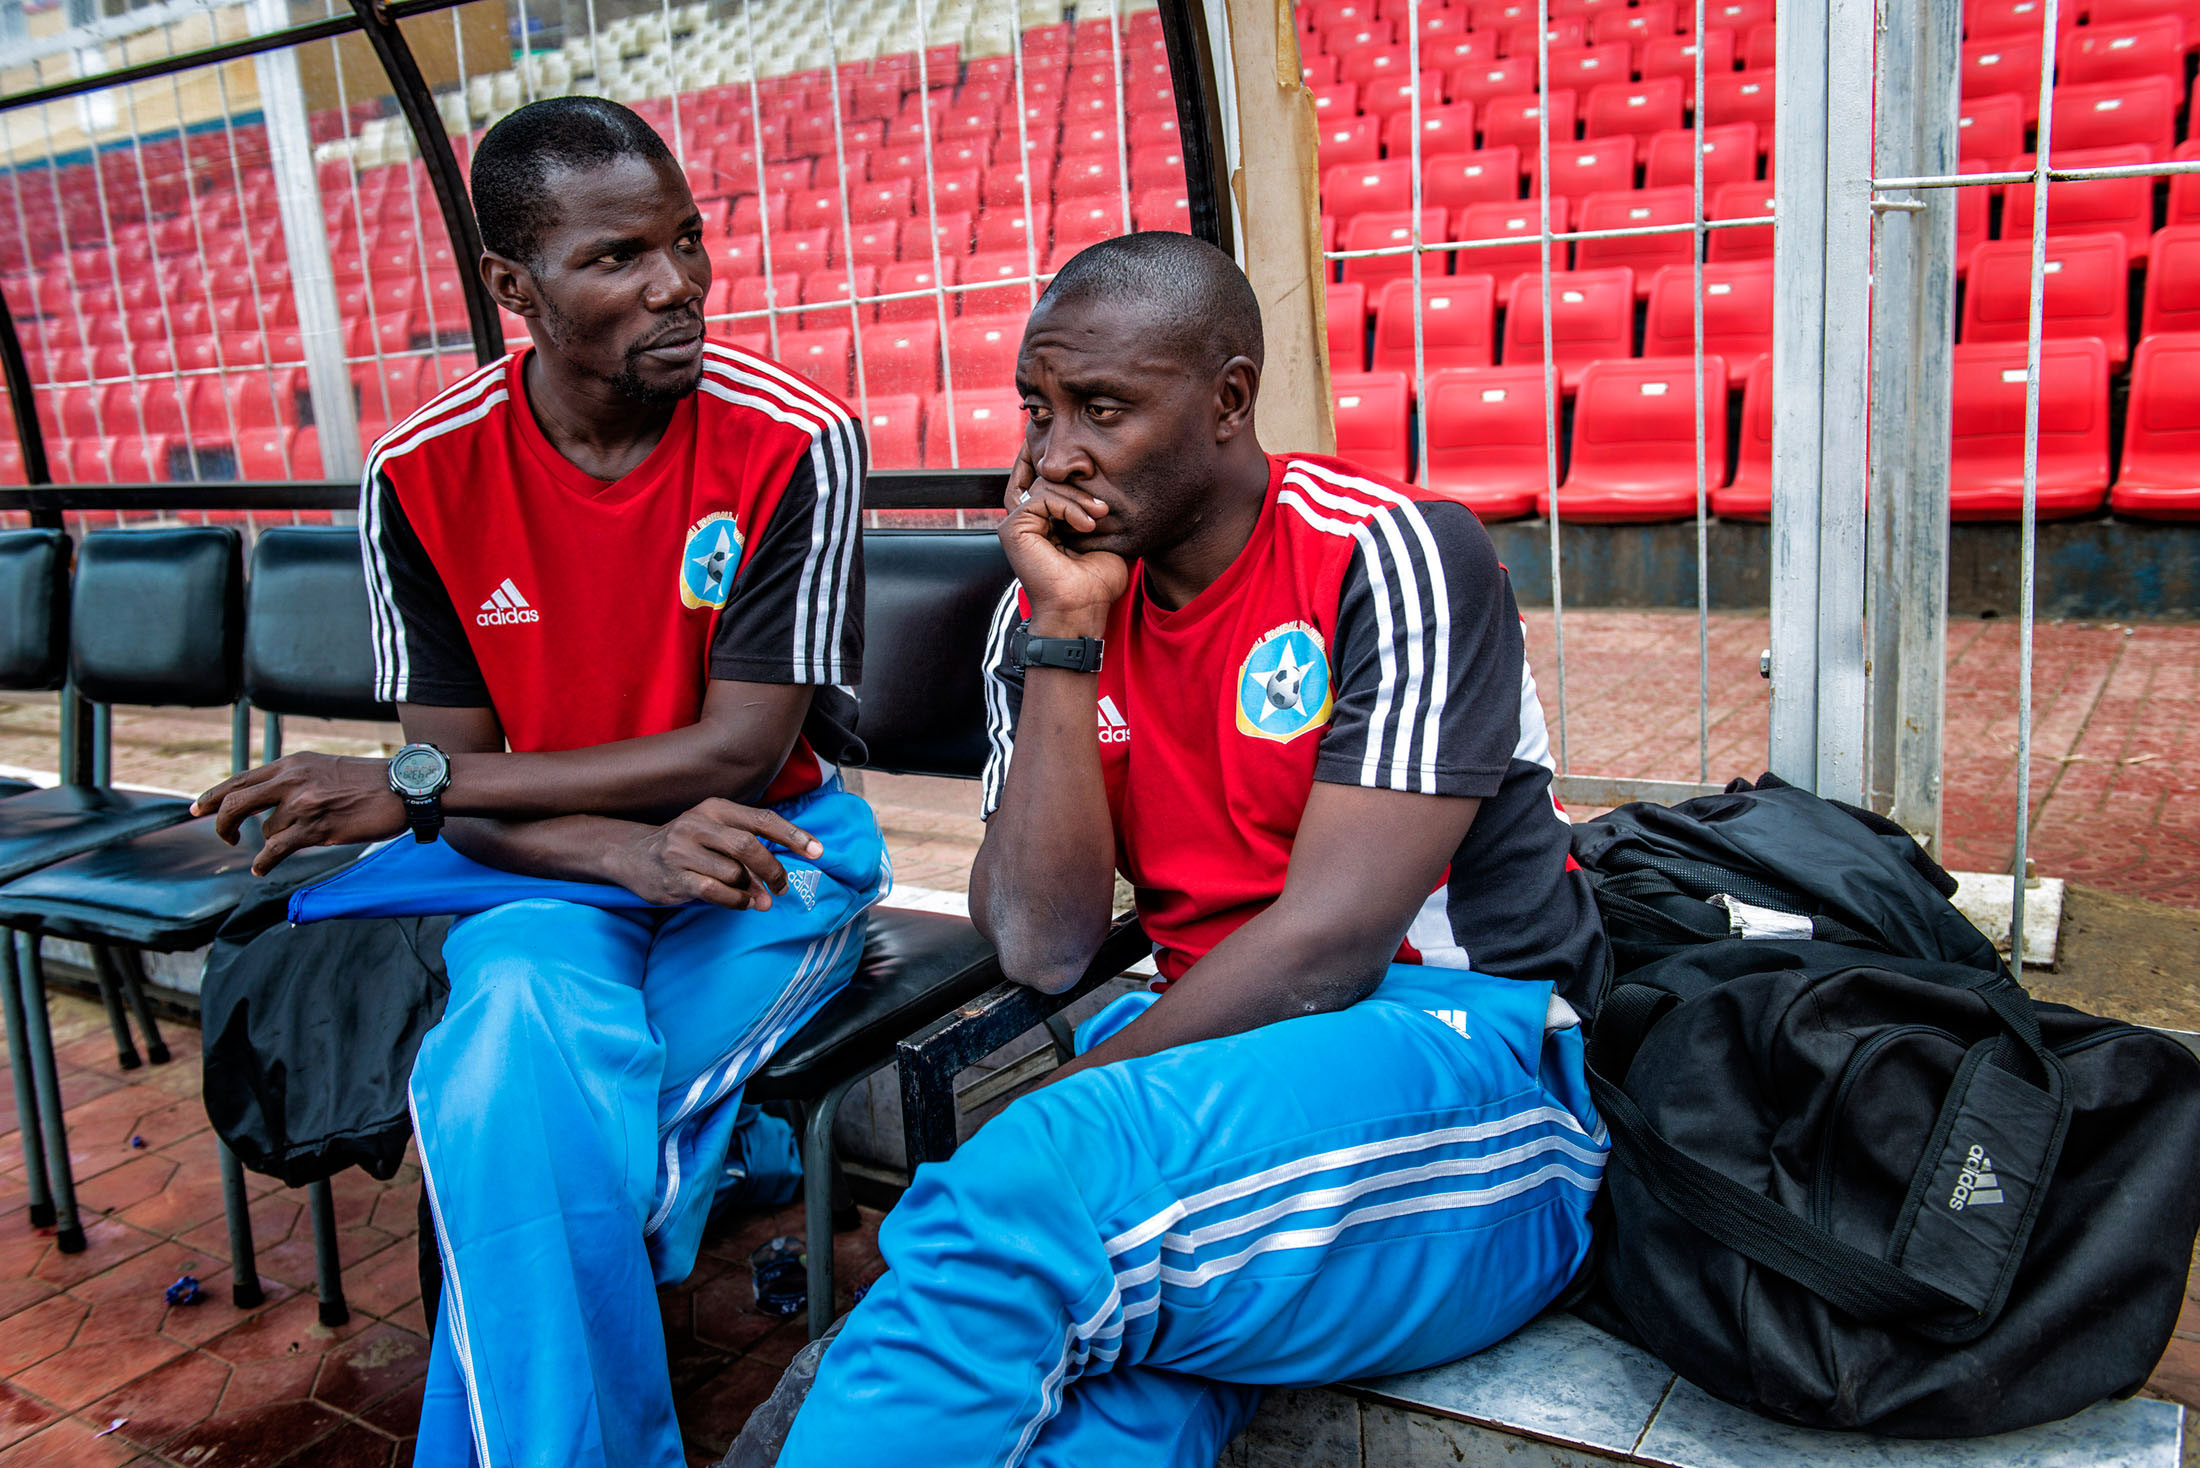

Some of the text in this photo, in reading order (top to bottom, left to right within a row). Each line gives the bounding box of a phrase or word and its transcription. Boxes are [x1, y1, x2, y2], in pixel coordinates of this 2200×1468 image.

[476, 607, 540, 626] adidas
[787, 871, 816, 911] adidas
[1948, 1144, 1985, 1211] adidas
